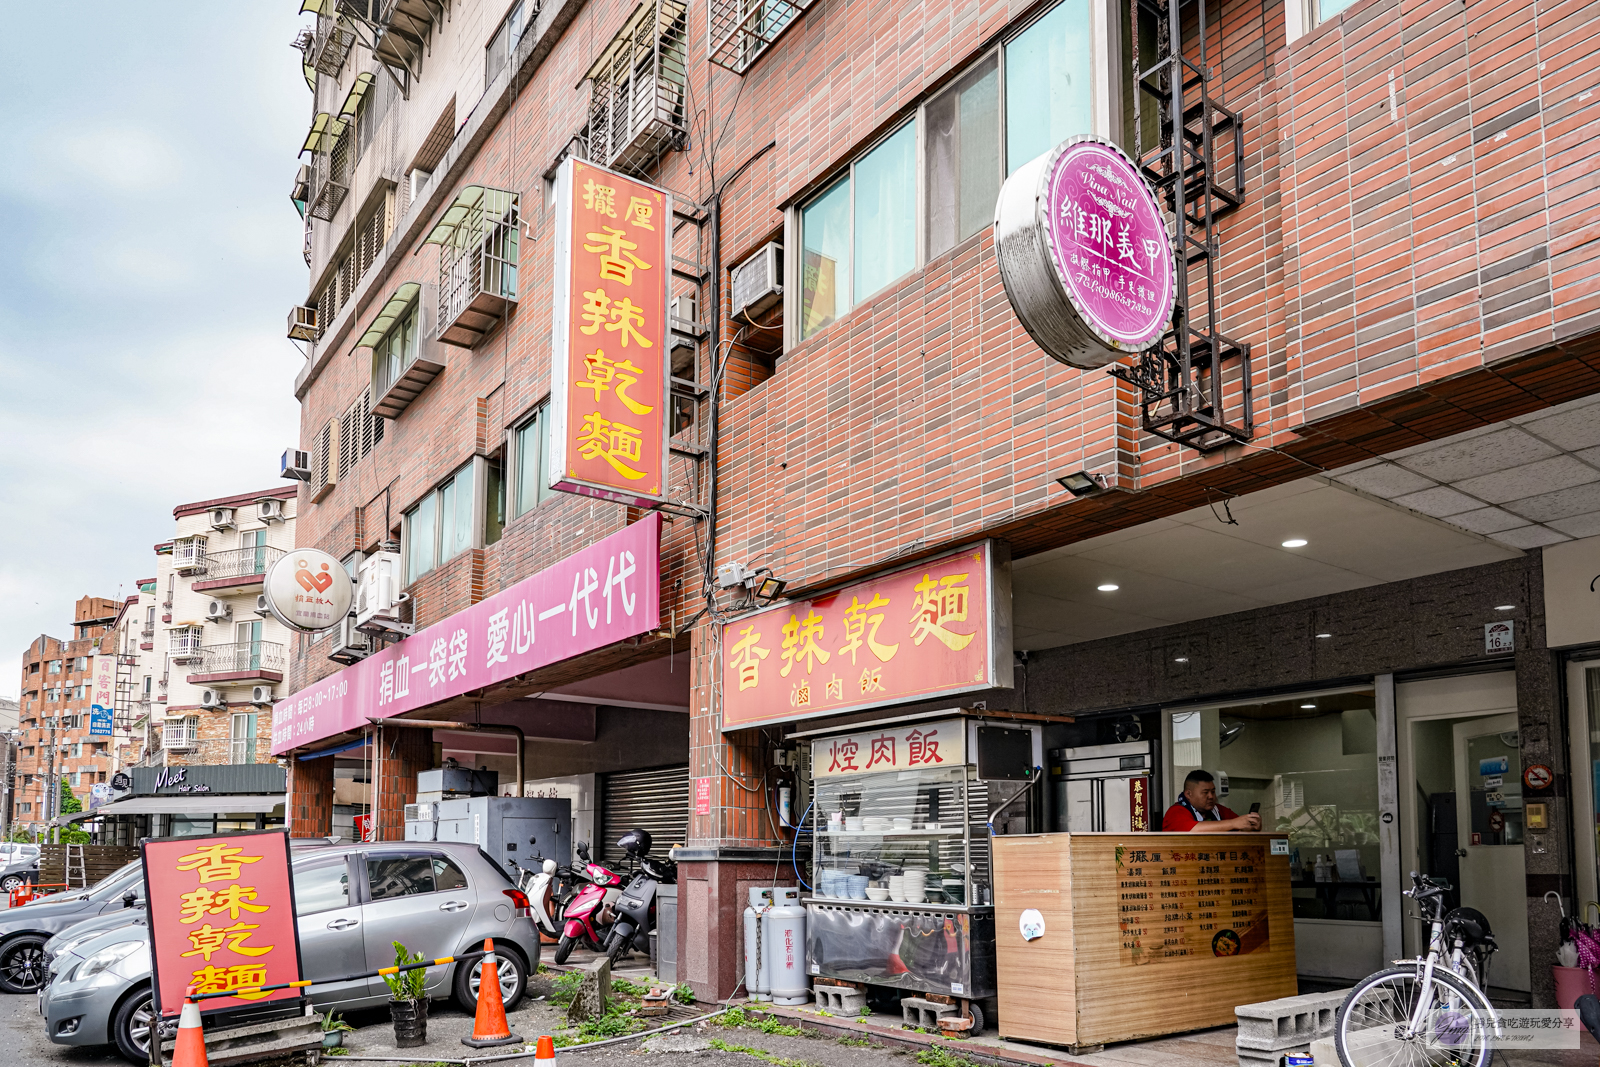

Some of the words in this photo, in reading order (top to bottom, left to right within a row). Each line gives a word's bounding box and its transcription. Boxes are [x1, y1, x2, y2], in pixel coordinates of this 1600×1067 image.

[582, 178, 655, 231] 擺厘
[1081, 171, 1109, 198] Vina
[1110, 190, 1138, 211] Nail
[1060, 194, 1162, 276] 維那美甲
[575, 225, 654, 480] 香辣乾麵
[379, 628, 468, 707] 捐血一袋袋
[486, 550, 636, 668] 愛心一代代
[729, 572, 977, 692] 香辣乾麵
[96, 658, 112, 706] 百客門
[790, 666, 886, 708] 滷肉飯
[828, 728, 944, 773] 焢肉飯
[154, 767, 187, 793] Meet
[178, 784, 191, 792] Hair
[193, 784, 210, 792] Salon
[1134, 780, 1144, 829] 恭賀新禧
[176, 842, 275, 1001] 香辣乾麵
[784, 929, 794, 970] 液化石油氣
